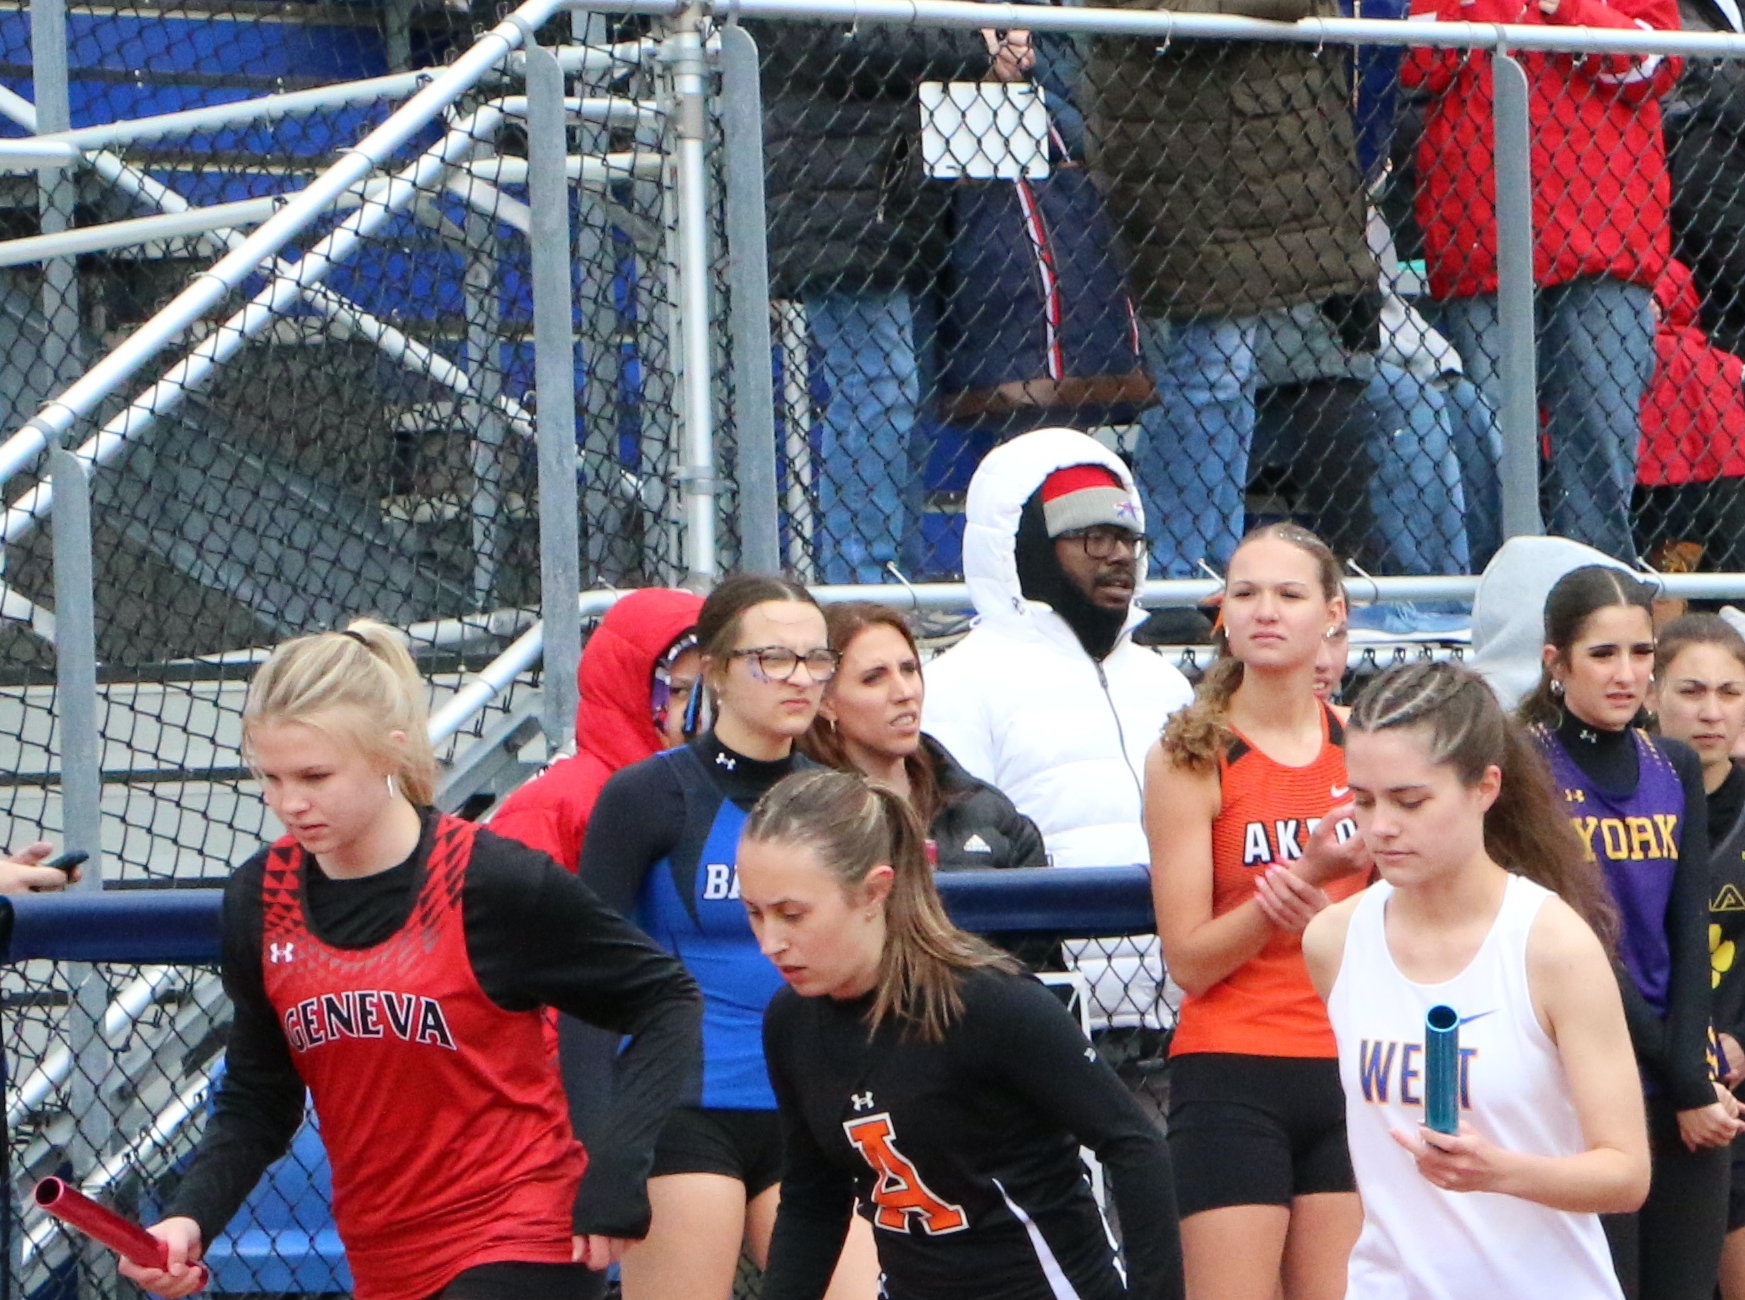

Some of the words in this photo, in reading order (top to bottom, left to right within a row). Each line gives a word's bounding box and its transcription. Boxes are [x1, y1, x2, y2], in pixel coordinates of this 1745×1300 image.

[1573, 814, 1680, 861] YORK
[284, 990, 457, 1053] GENEVA
[1359, 1038, 1478, 1111] WET
[842, 1112, 970, 1236] A
